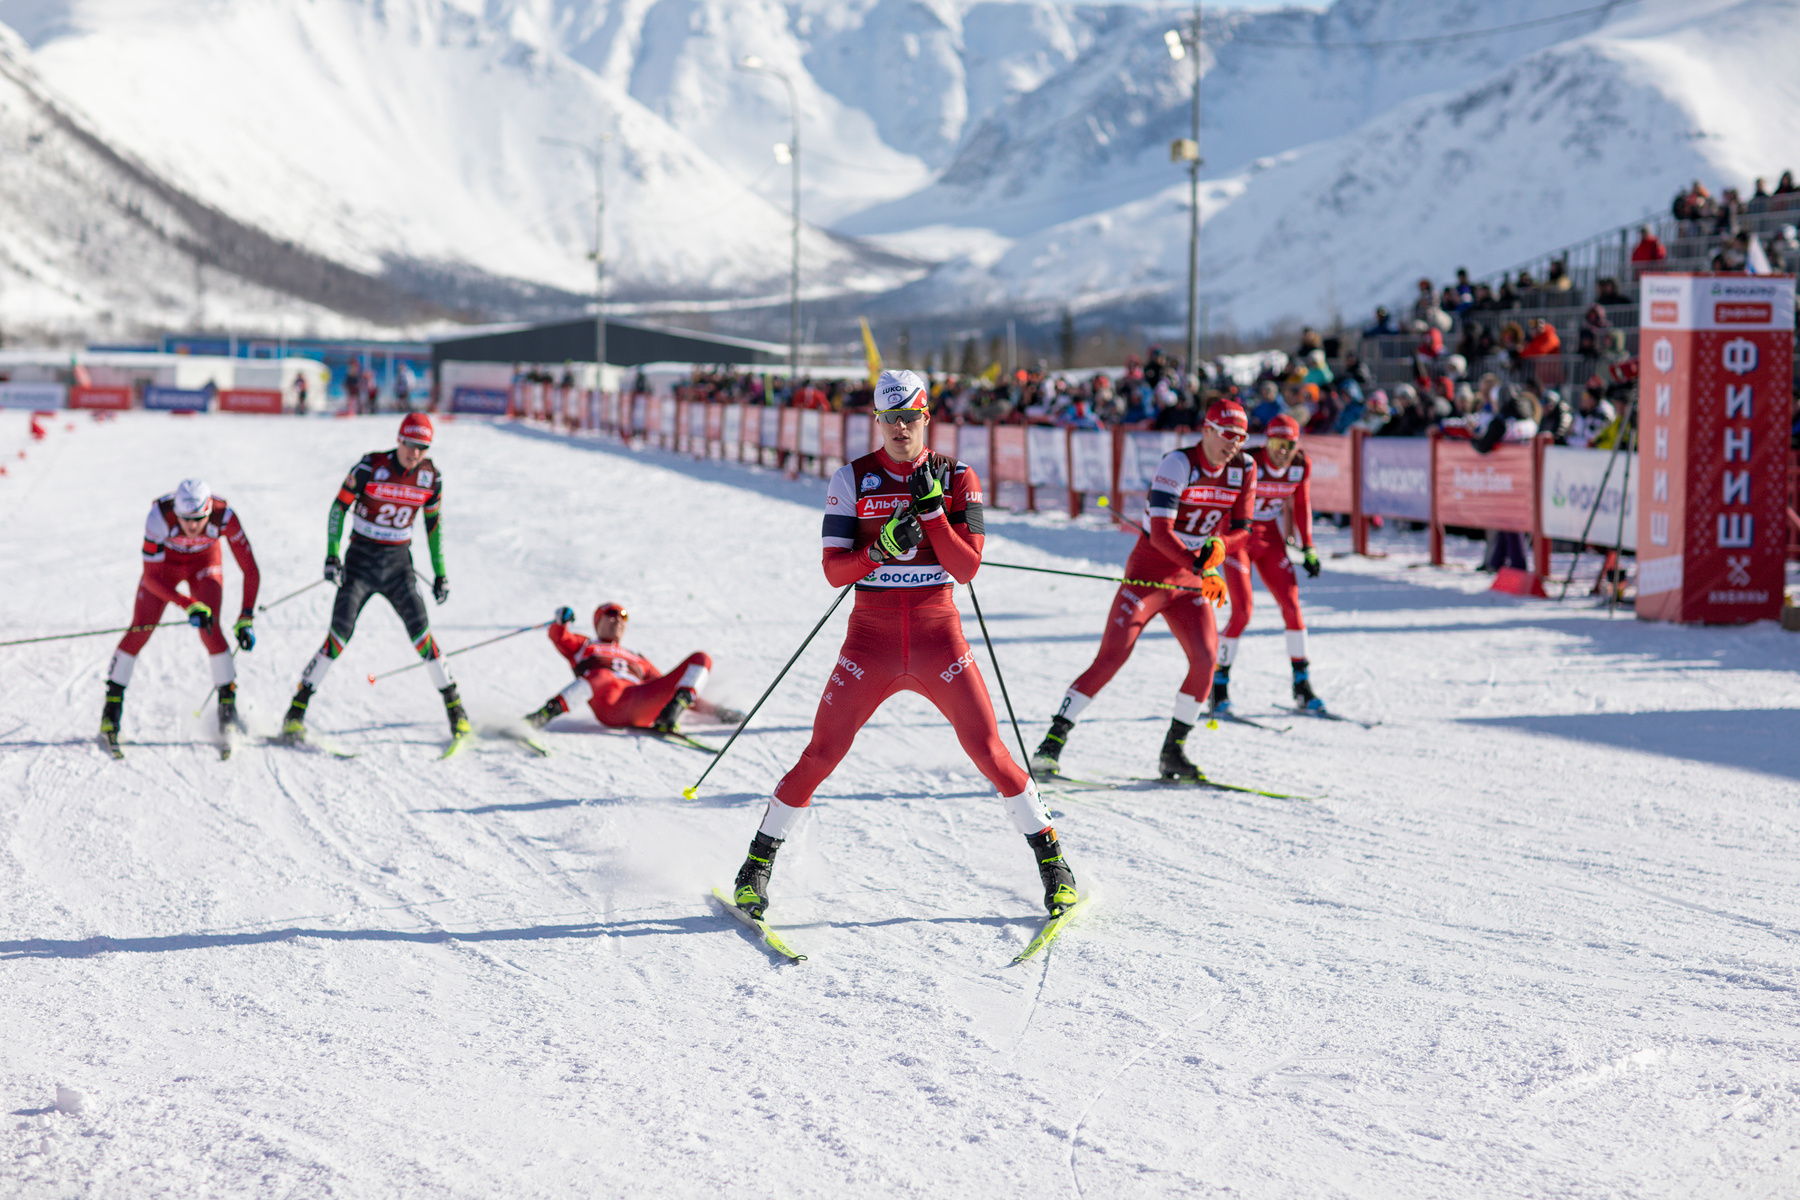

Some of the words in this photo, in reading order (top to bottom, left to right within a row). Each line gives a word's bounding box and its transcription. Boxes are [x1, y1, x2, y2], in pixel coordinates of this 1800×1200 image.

[882, 385, 909, 395] LUKOIL
[1653, 337, 1673, 547] ФИНИШ
[1716, 337, 1758, 548] ФИНИШ
[1185, 508, 1223, 535] 18
[879, 571, 943, 583] ФОСАГРО
